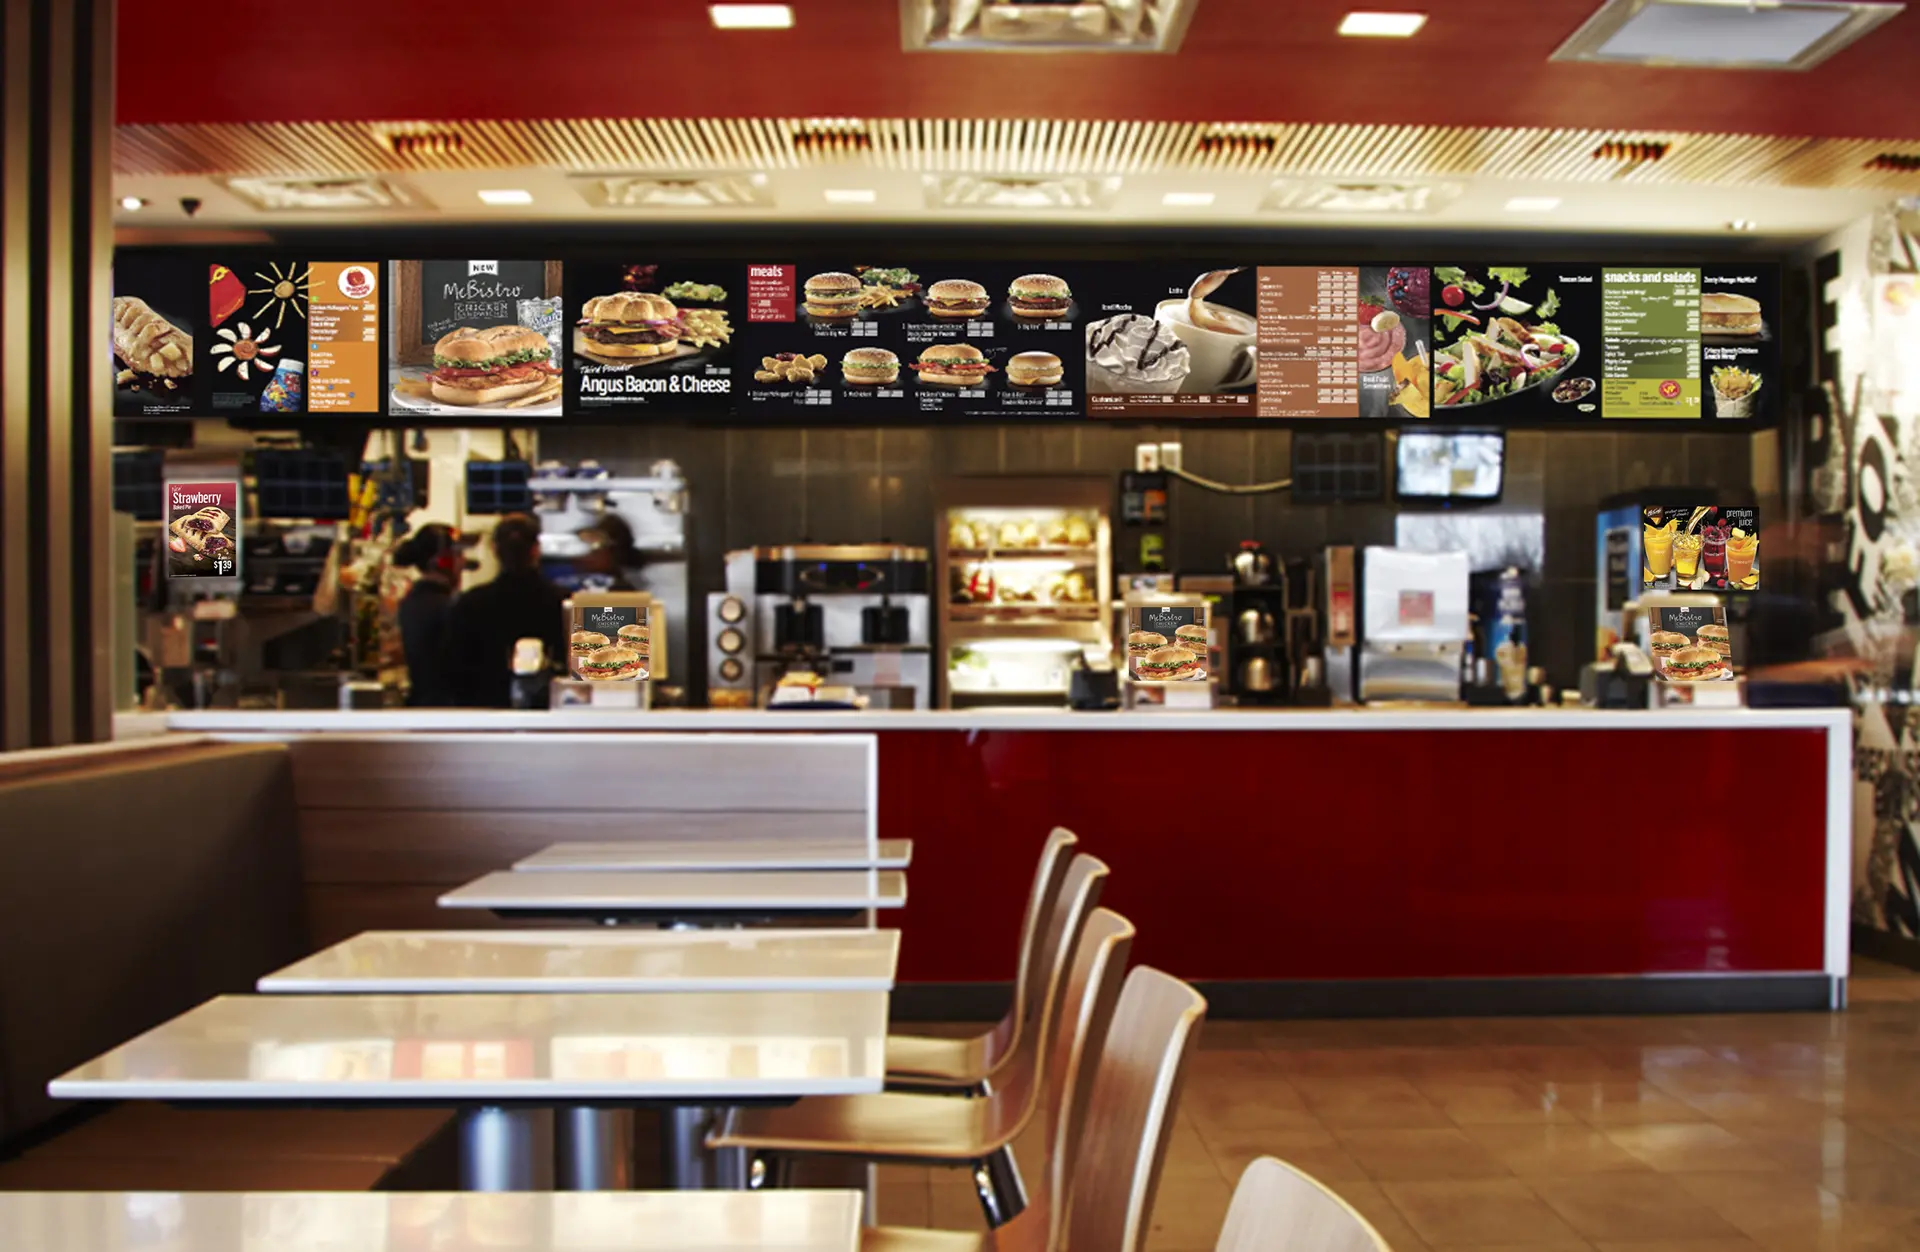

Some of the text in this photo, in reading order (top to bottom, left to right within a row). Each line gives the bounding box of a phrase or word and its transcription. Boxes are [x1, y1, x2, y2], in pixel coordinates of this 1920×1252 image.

[473, 264, 495, 272] NEW
[751, 265, 783, 277] meals
[1578, 275, 1593, 283] Salad
[1604, 271, 1697, 283] snacks and salads
[443, 279, 522, 300] McBistro
[457, 302, 508, 311] CHICKEN
[1102, 303, 1133, 311] Iced Mocha
[580, 365, 600, 375] Third
[580, 375, 731, 396] Angus Bacon & Cheese
[173, 491, 221, 506] Strawberry
[1726, 508, 1753, 518] premium
[1738, 518, 1753, 528] juice
[591, 612, 625, 622] McBistro
[1148, 612, 1183, 622] McBistro
[1668, 612, 1702, 622] McBistro
